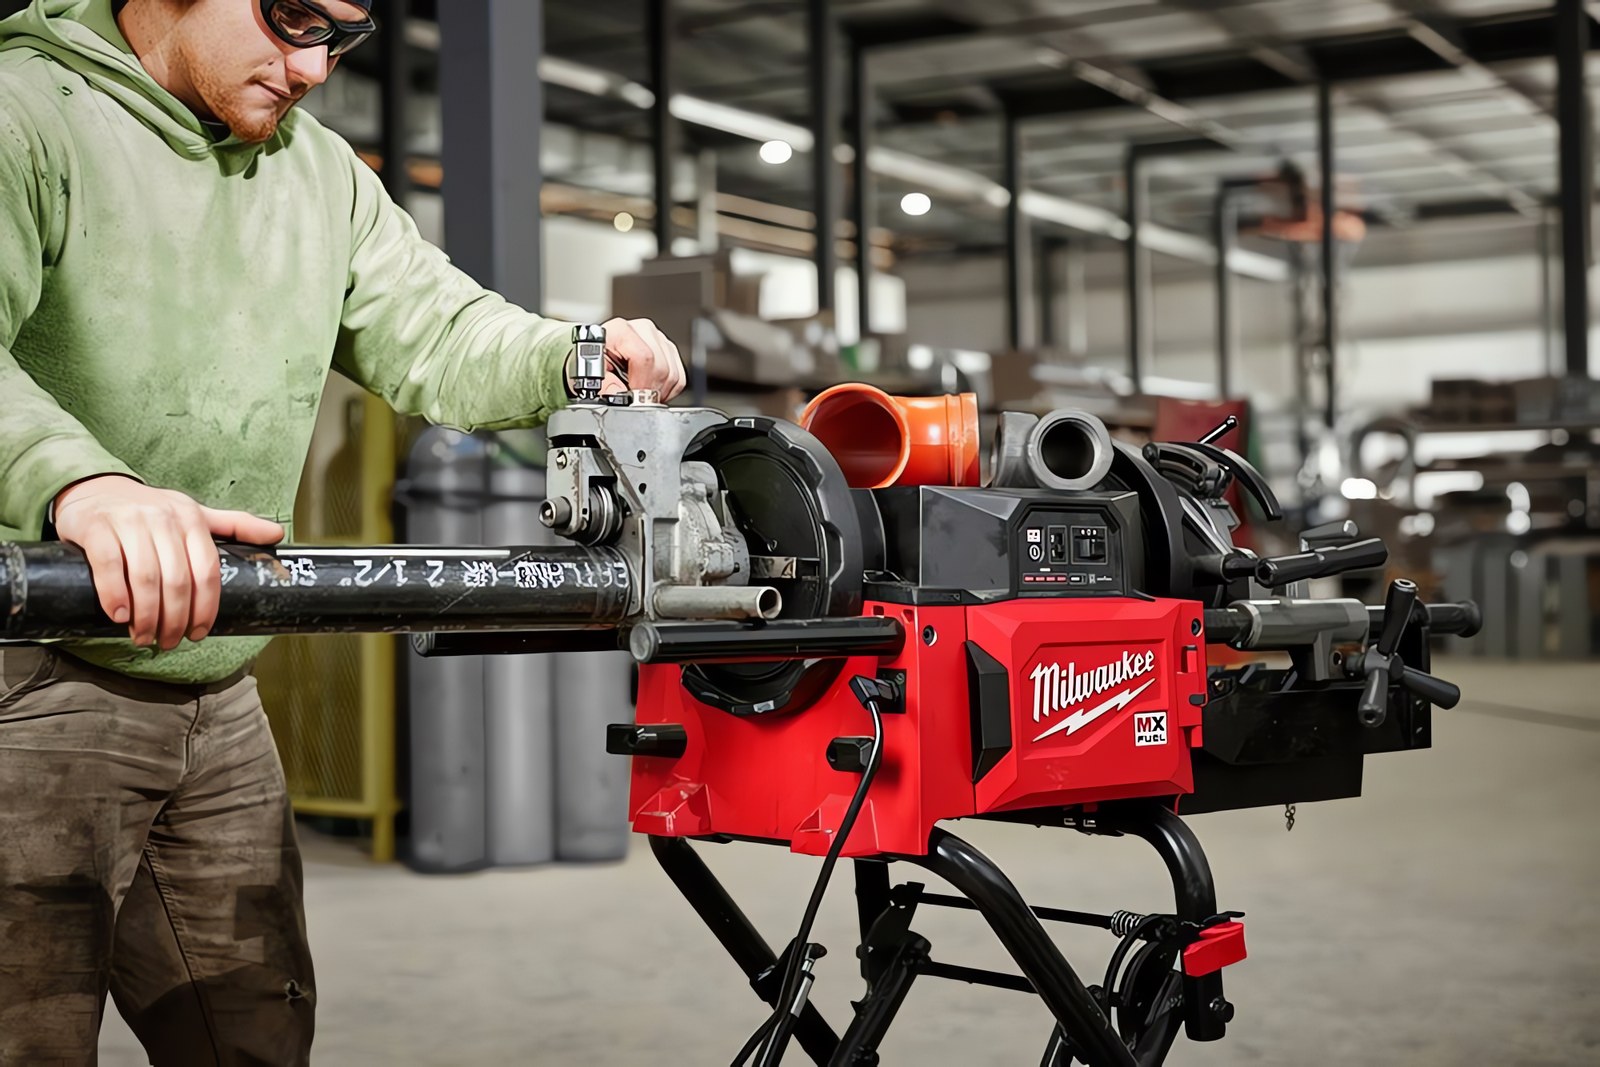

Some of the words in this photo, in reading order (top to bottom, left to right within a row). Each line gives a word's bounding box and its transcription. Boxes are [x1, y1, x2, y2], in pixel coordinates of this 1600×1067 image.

[424, 559, 446, 588] 2
[1029, 650, 1155, 723] Milwaukee
[1137, 716, 1165, 732] MX
[1137, 734, 1166, 743] FUEL
